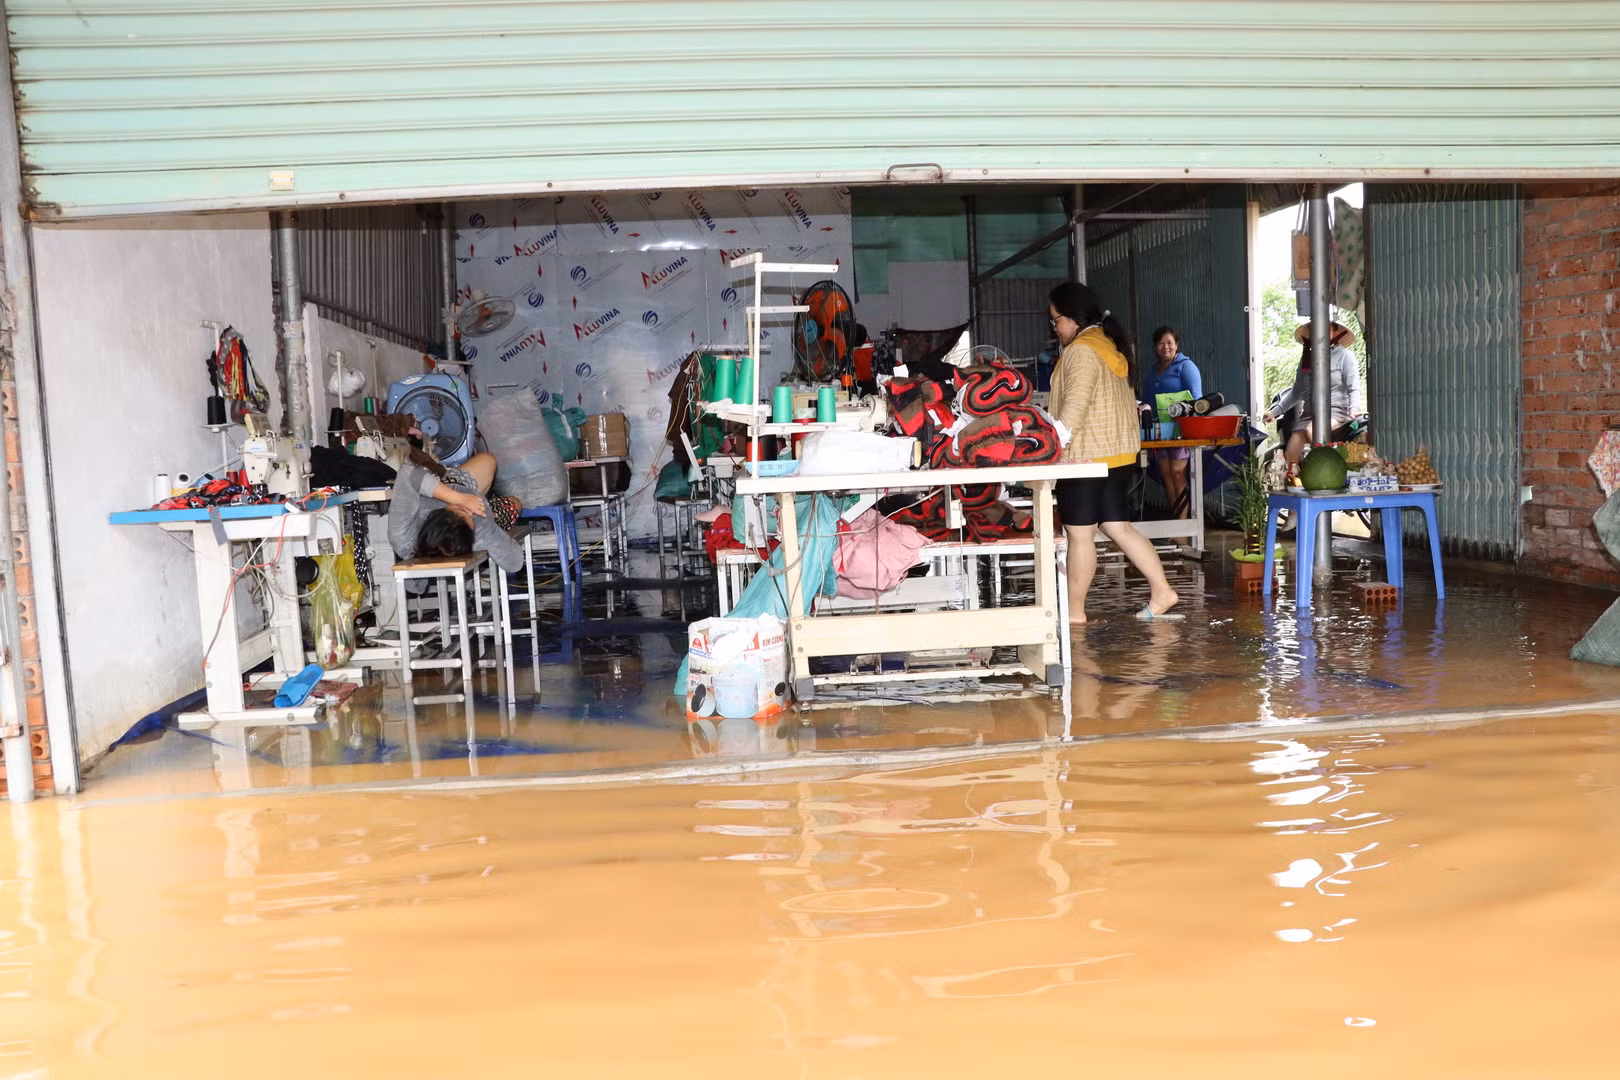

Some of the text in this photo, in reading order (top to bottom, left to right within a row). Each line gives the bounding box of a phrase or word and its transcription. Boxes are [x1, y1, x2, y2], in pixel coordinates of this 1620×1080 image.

[641, 256, 688, 288] ALUVINA
[574, 307, 620, 340] ALUVINA
[500, 330, 546, 362] ALUVINA
